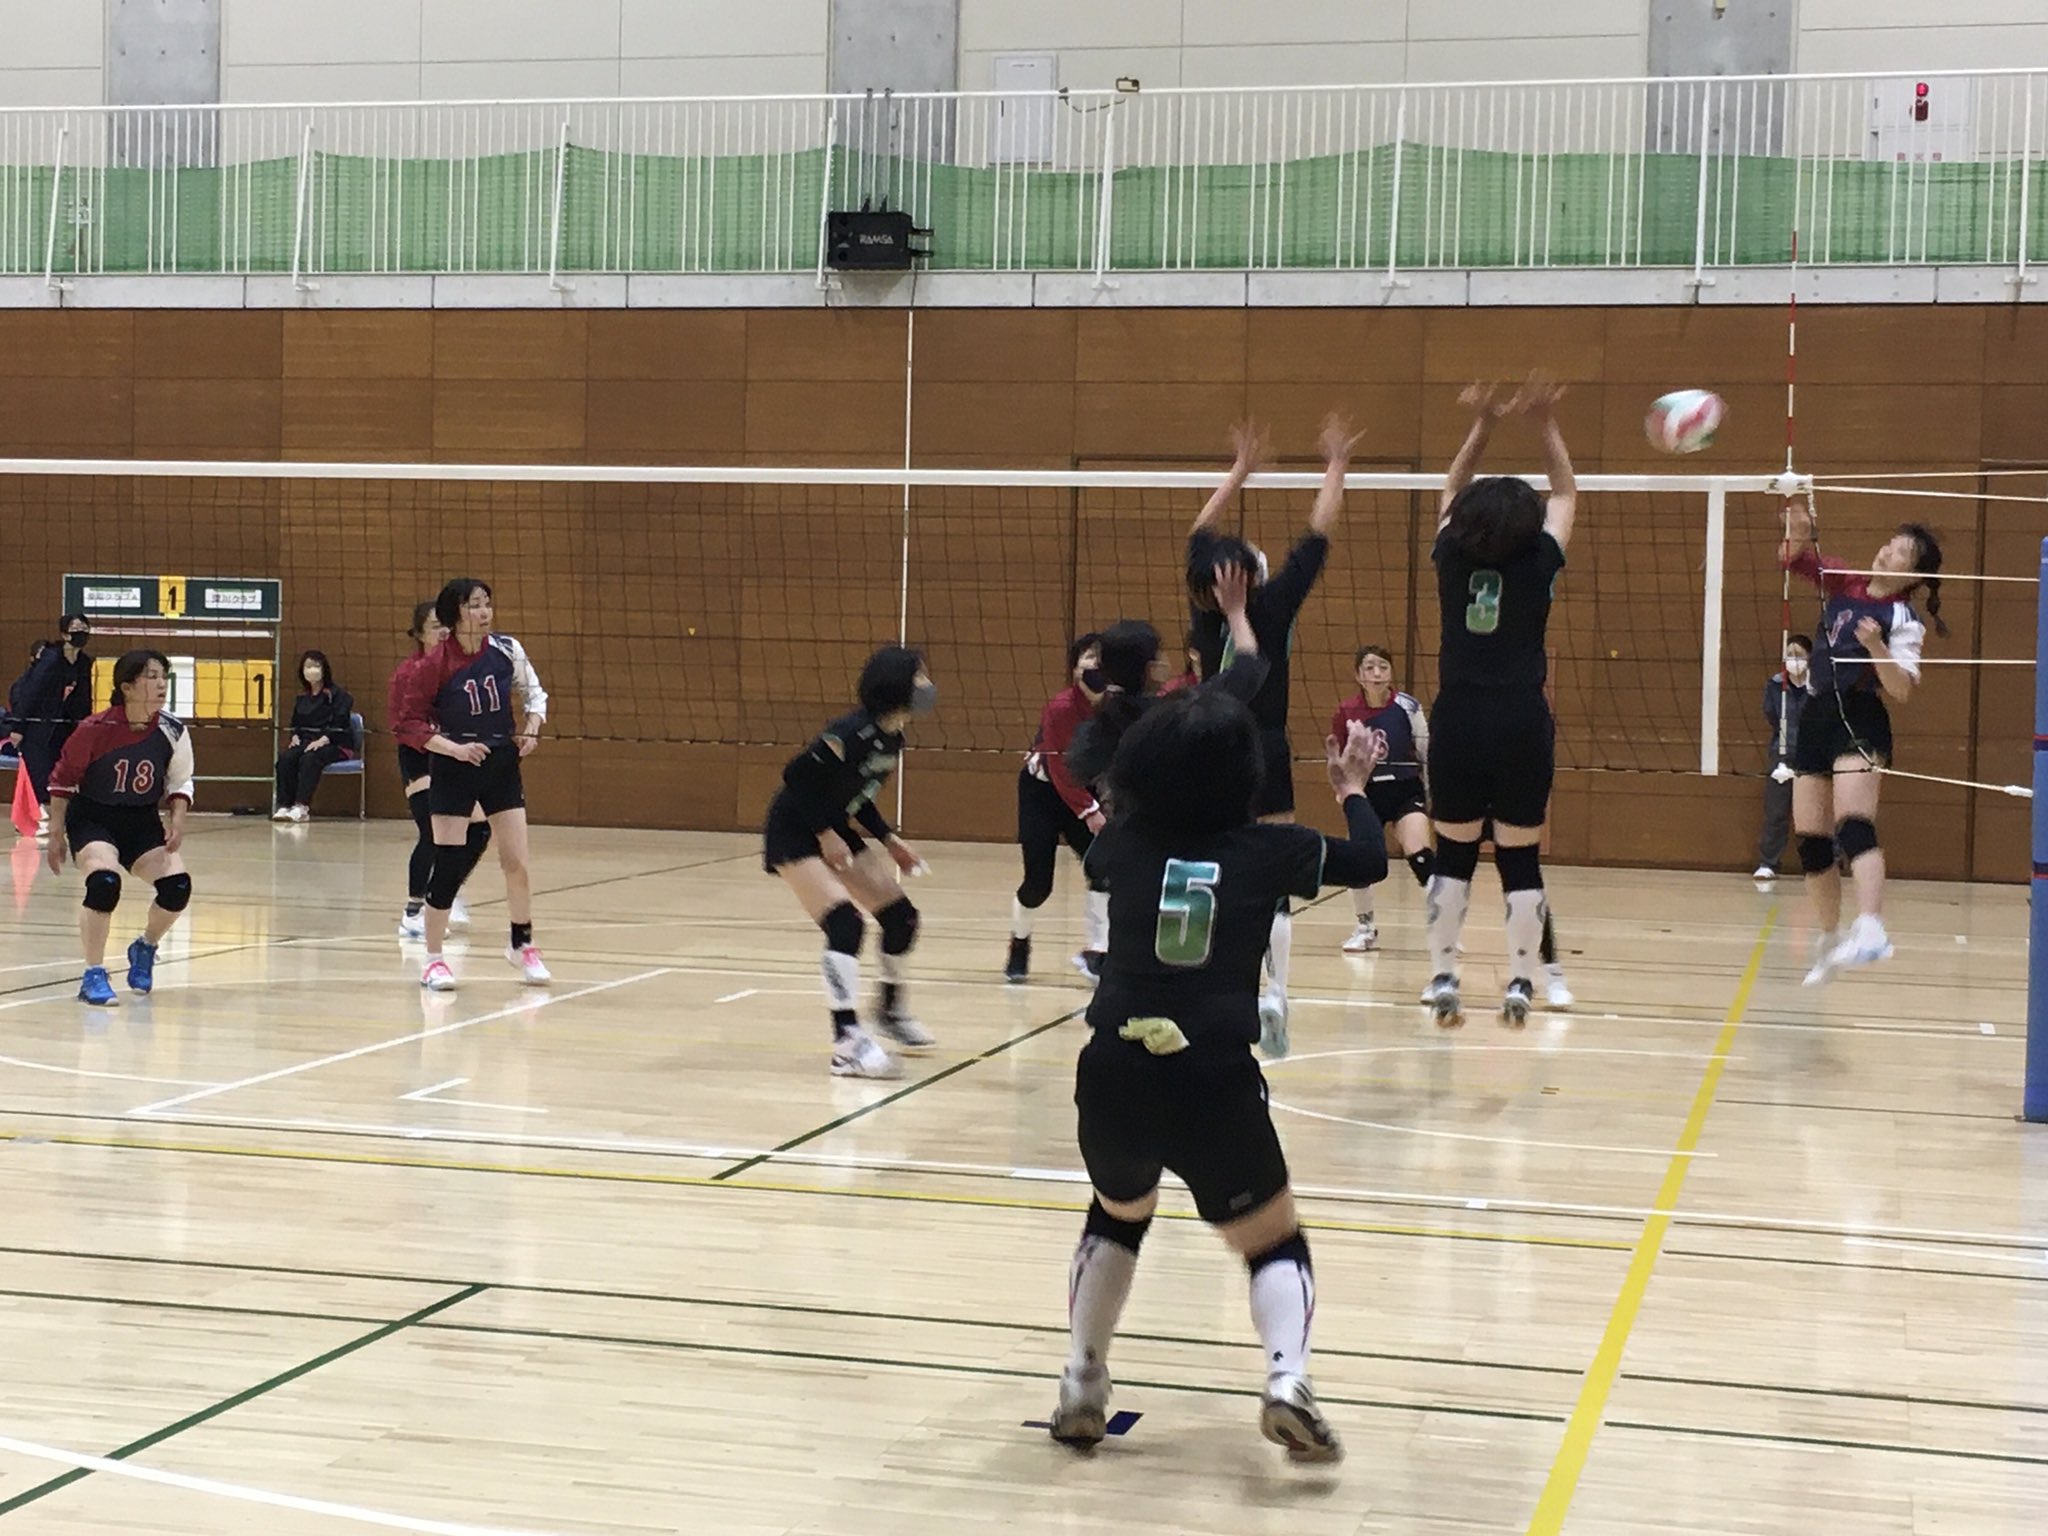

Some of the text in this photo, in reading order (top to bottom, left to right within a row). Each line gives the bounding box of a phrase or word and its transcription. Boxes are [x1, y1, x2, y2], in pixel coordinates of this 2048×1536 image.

[859, 234, 894, 245] RAMSA
[168, 586, 177, 611] 1
[1466, 569, 1502, 634] 3
[253, 673, 265, 714] 1
[464, 674, 501, 716] 11
[1155, 858, 1221, 967] 5
